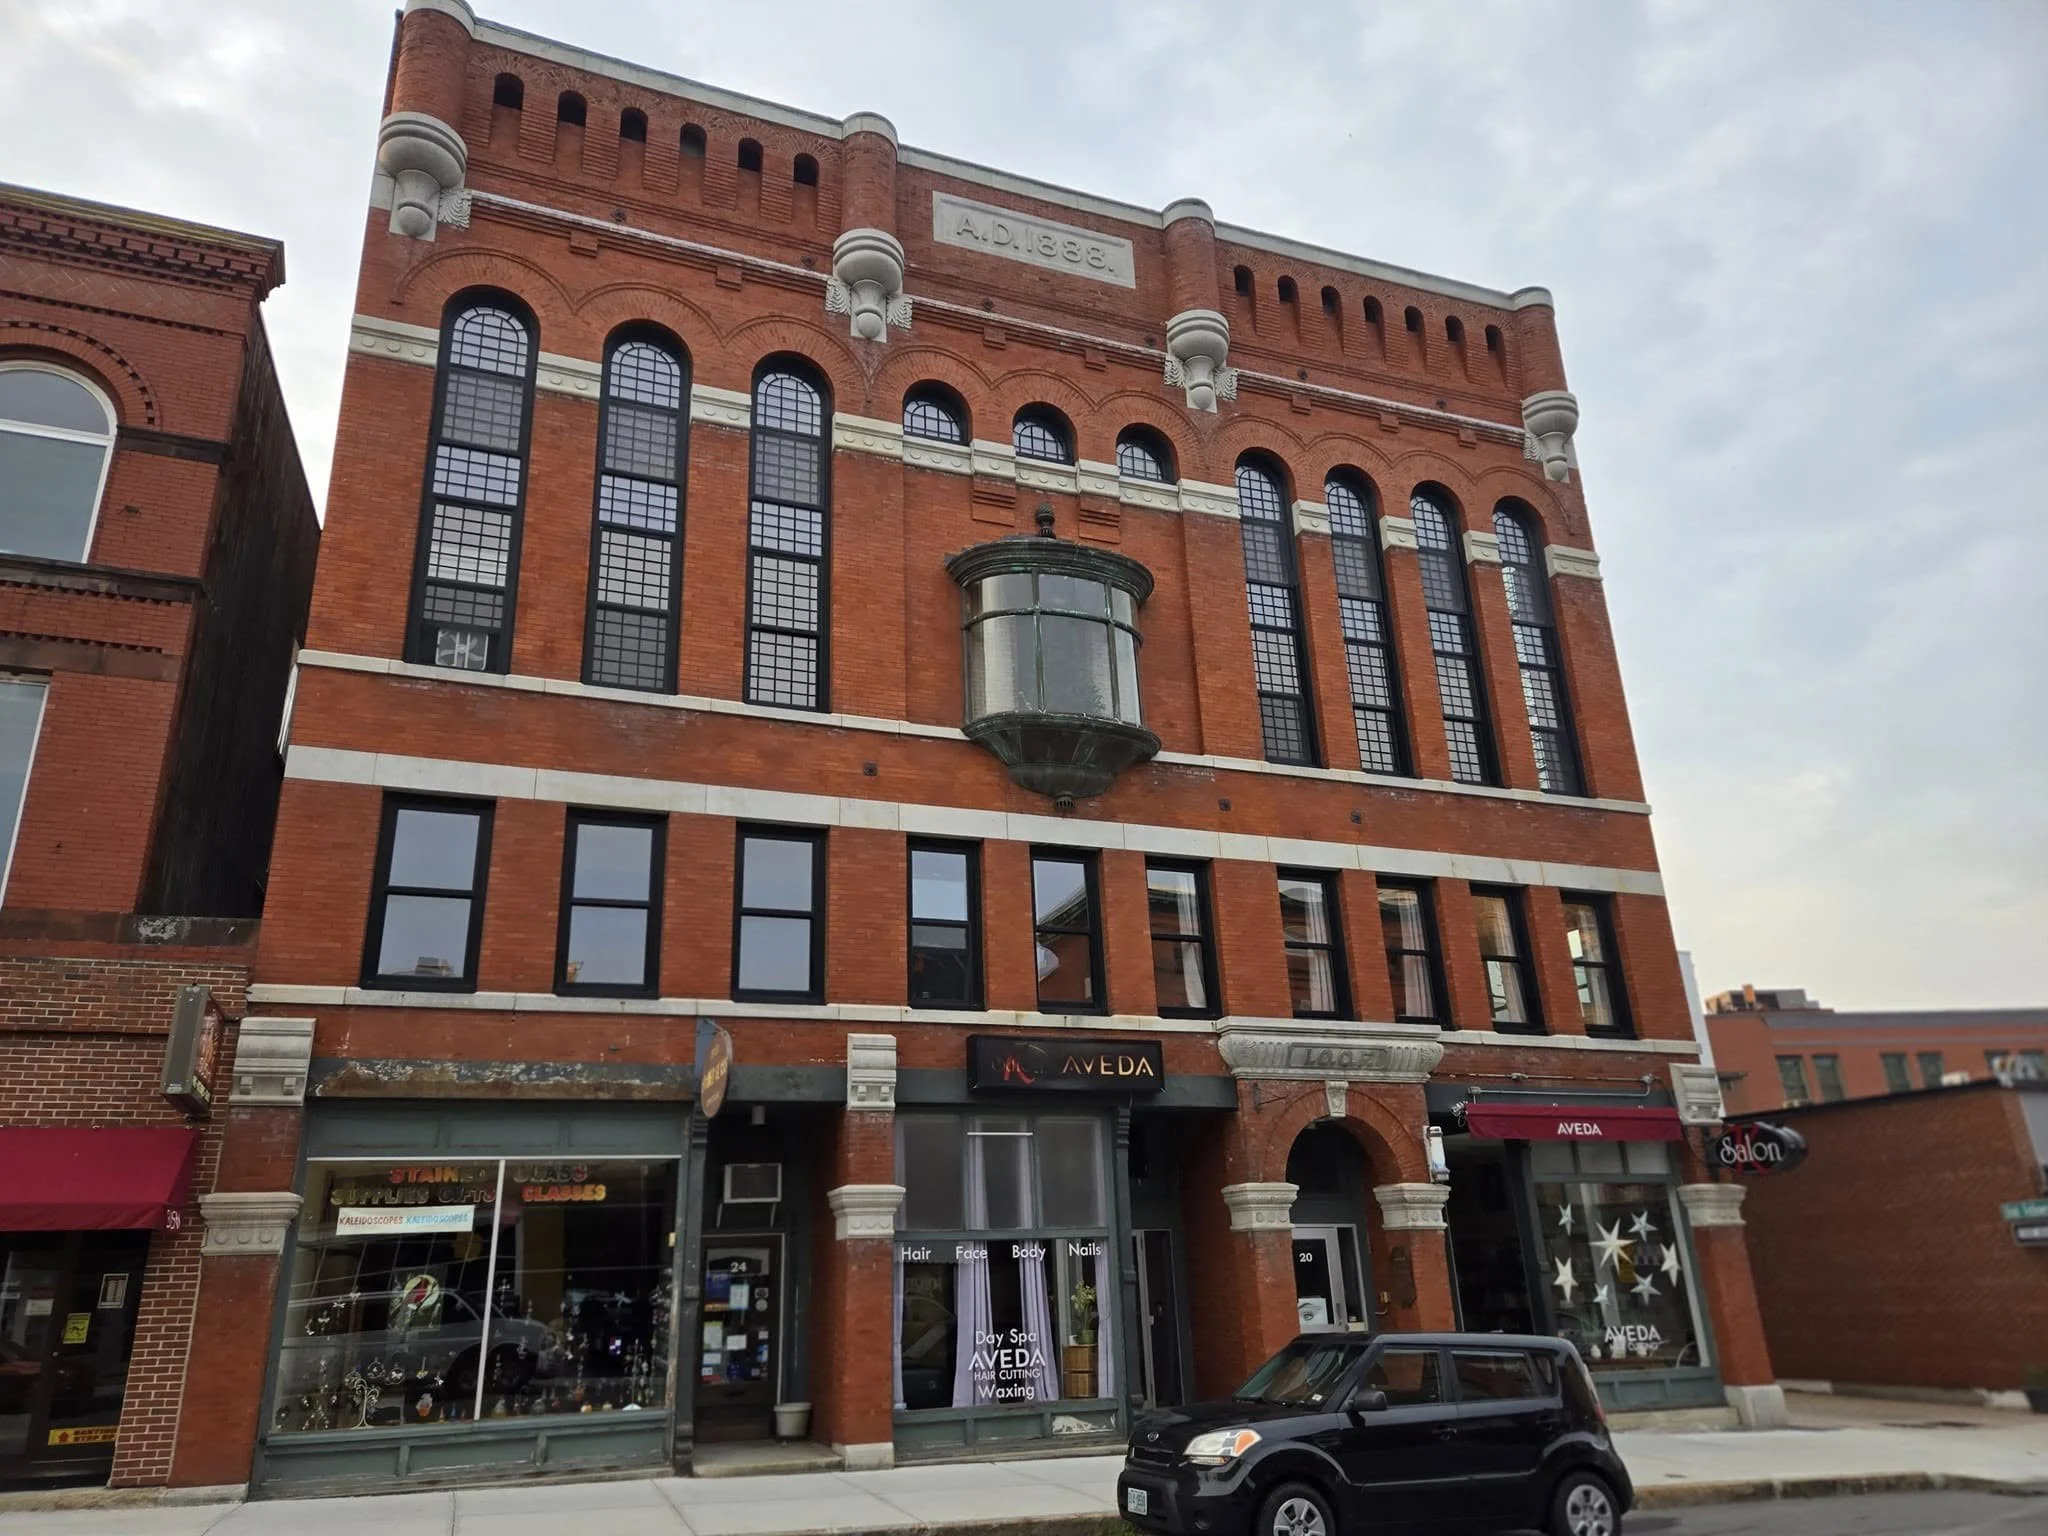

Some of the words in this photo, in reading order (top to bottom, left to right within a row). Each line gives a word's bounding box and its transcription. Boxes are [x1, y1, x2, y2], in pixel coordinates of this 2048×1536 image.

[1062, 1054, 1154, 1077] AVEDA
[1557, 1122, 1603, 1136] AVEDA
[1720, 1133, 1783, 1164] Salon
[339, 1216, 404, 1226] KALEIDOSCOPES
[406, 1213, 469, 1225] KALEIDOSCOPES
[901, 1247, 932, 1261] Hair
[955, 1246, 988, 1260] Face
[1012, 1244, 1046, 1262] Body
[1069, 1243, 1102, 1257] Nails
[1299, 1252, 1313, 1262] 20
[730, 1262, 747, 1272] 24
[975, 1330, 1004, 1348] Day
[1010, 1328, 1037, 1346] Spa
[1604, 1325, 1661, 1343] AVEDA
[968, 1348, 1046, 1370] AVEDA
[974, 1371, 996, 1380] HAIR
[999, 1368, 1041, 1380] CUTTING
[978, 1383, 1035, 1400] Waxing
